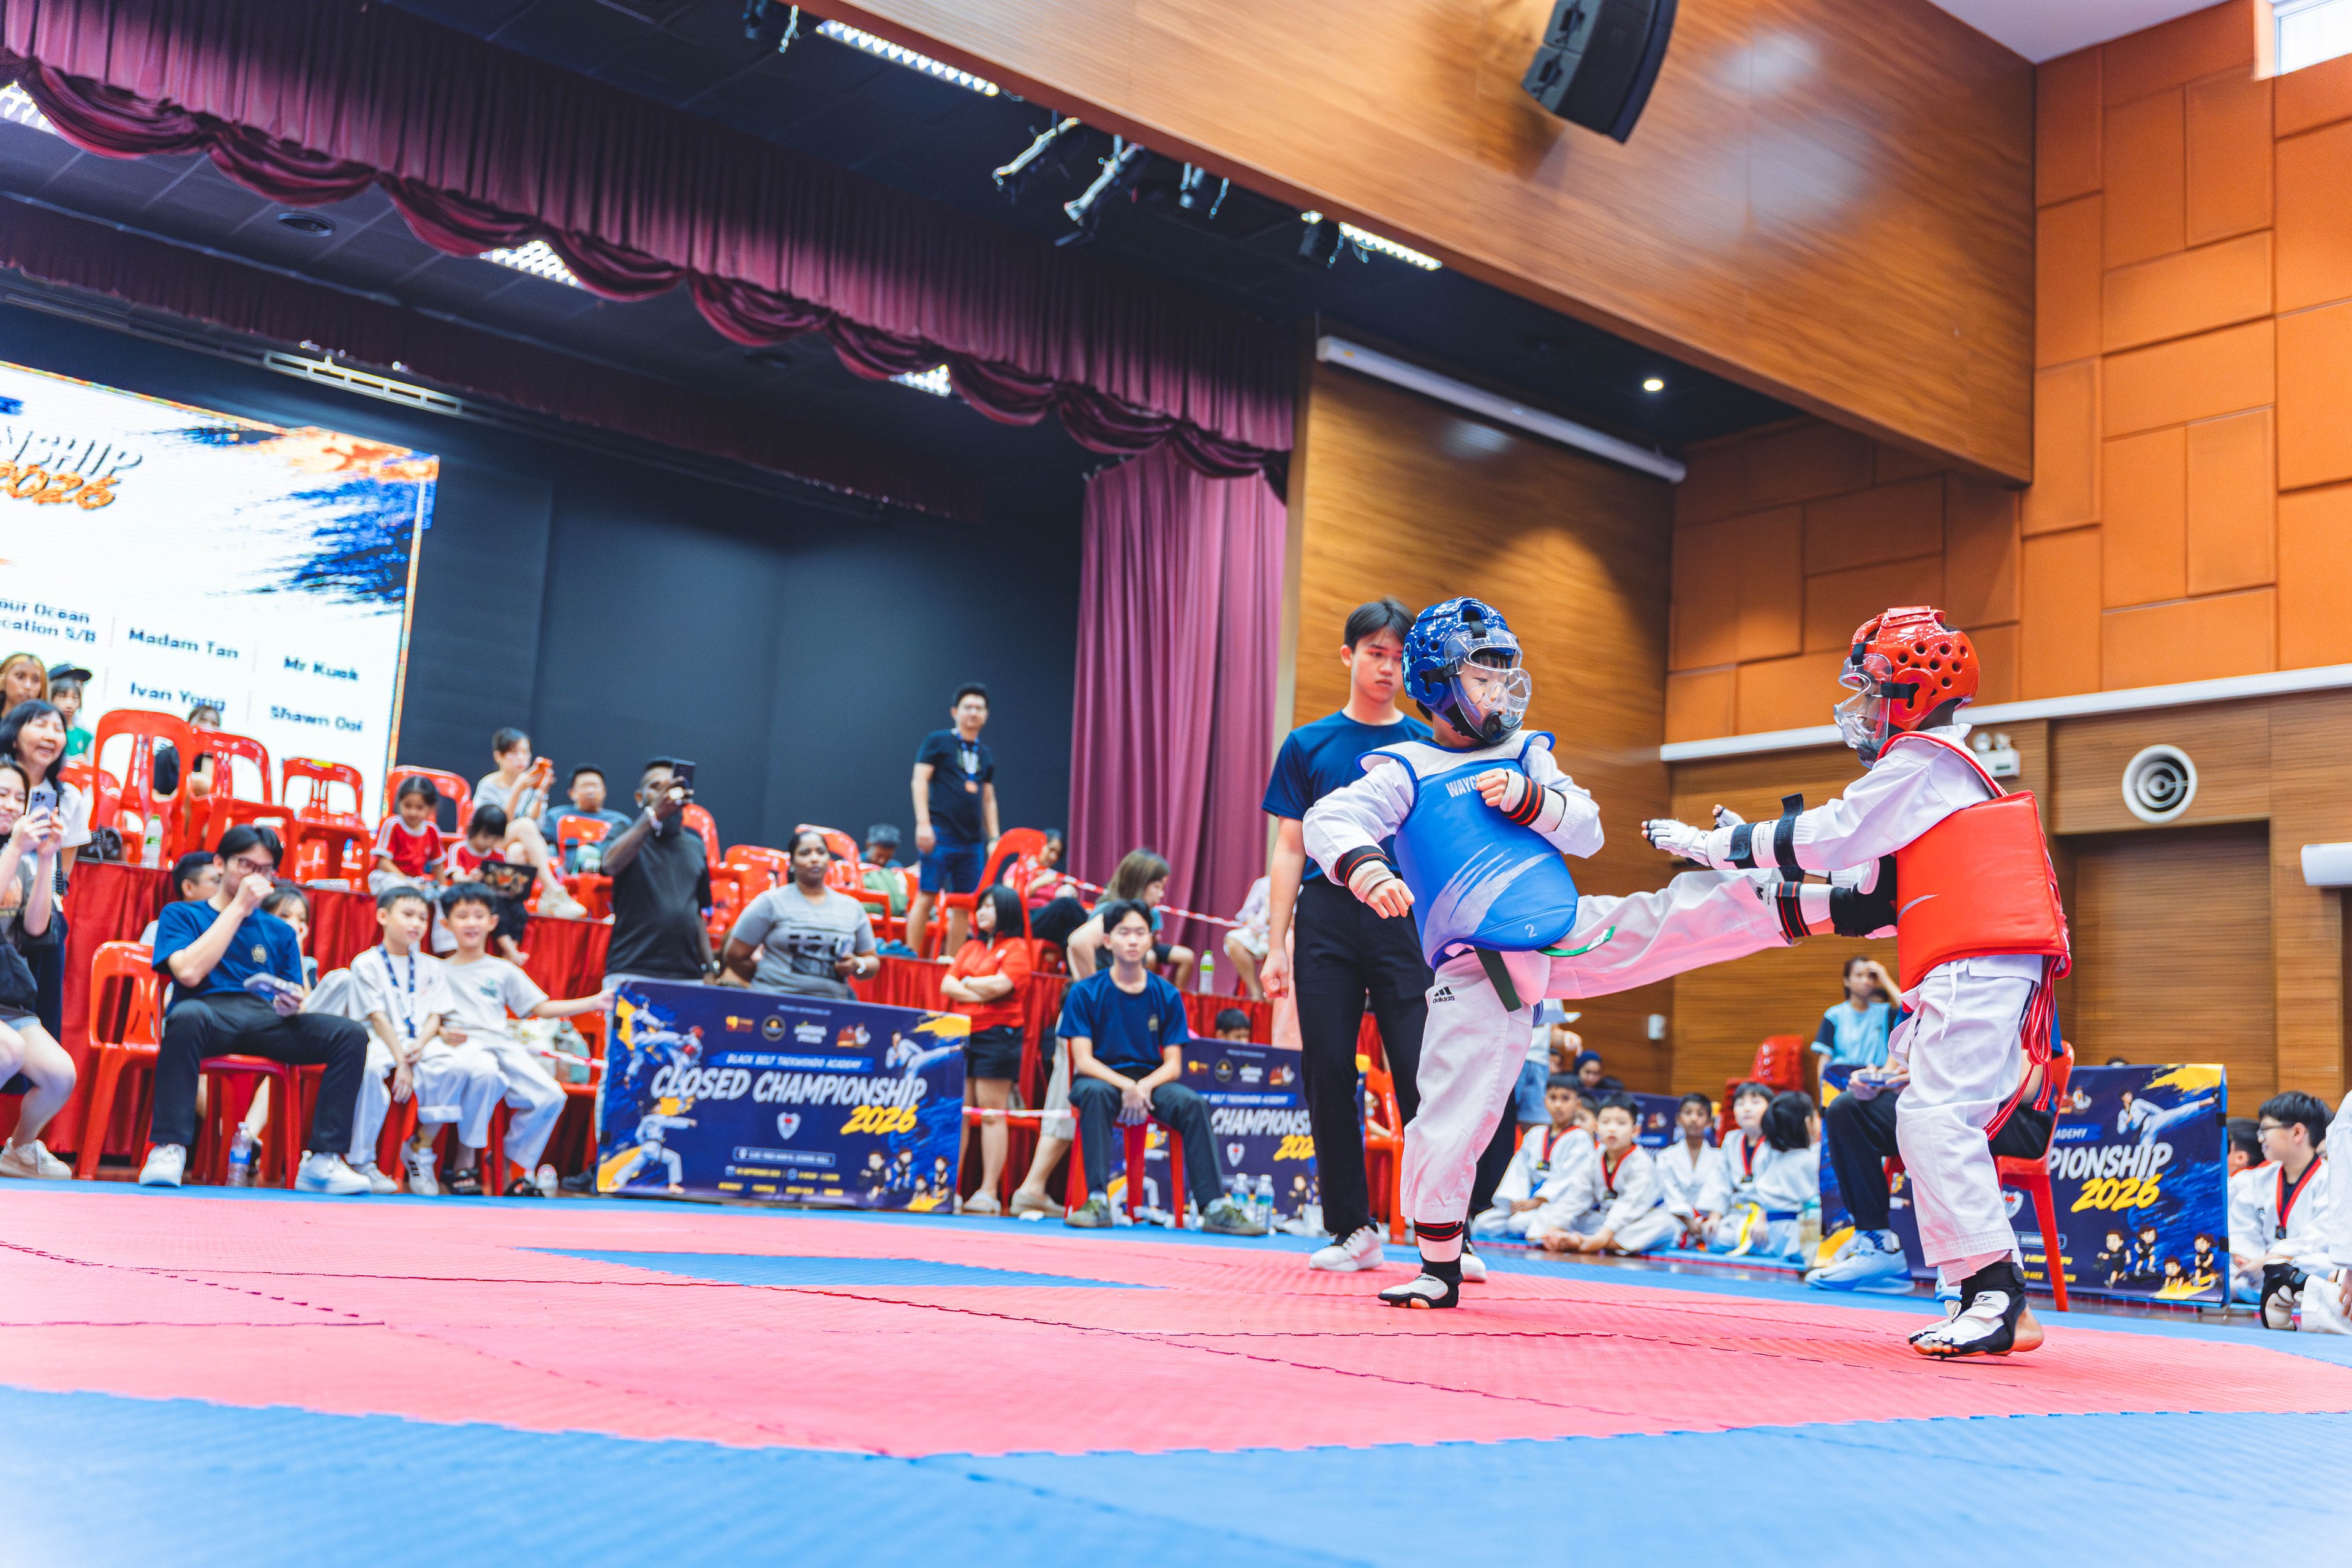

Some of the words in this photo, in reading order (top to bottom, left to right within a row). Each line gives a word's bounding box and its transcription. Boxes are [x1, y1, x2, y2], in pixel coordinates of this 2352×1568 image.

[0, 426, 143, 477] NSHIP
[0, 598, 27, 612] our
[34, 603, 89, 624] Ocean
[0, 617, 58, 636] cation
[129, 628, 199, 652] Madam
[207, 641, 239, 658] Tan
[284, 657, 306, 671] Mr
[130, 682, 172, 701] Ivan
[270, 705, 330, 726] Shawn
[1525, 924, 1537, 938] 2
[650, 1065, 752, 1101] CLOSED
[752, 1071, 927, 1107] CHAMPIONSHIP
[840, 1104, 918, 1135] 2026
[1211, 1107, 1311, 1136] CHAMPIONS
[2054, 1128, 2087, 1139] ADEMY
[1273, 1134, 1315, 1161] 202
[2049, 1142, 2173, 1181] PIONSHIP
[2071, 1174, 2163, 1212] 2026
